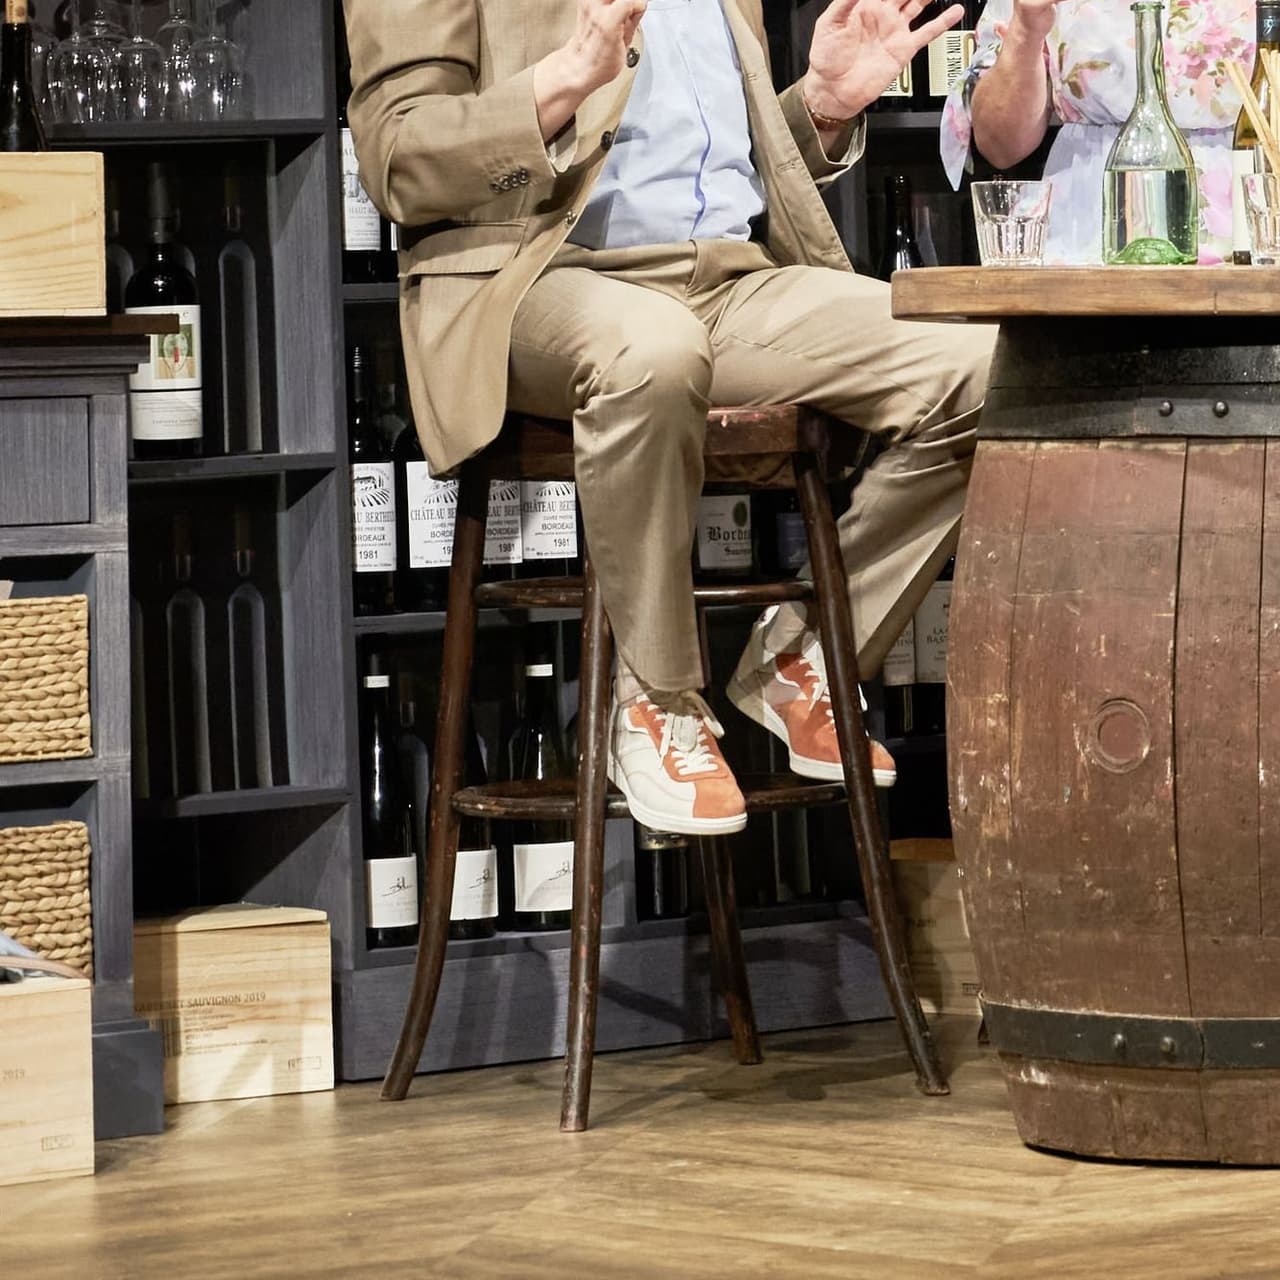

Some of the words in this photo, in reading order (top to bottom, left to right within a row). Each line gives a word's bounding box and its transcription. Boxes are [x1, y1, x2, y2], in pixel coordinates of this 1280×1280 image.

[554, 538, 570, 547] 1981
[499, 543, 515, 553] 1981
[359, 550, 379, 560] 1981
[186, 994, 241, 1009] SAUVIGNON
[244, 991, 266, 1004] 2019
